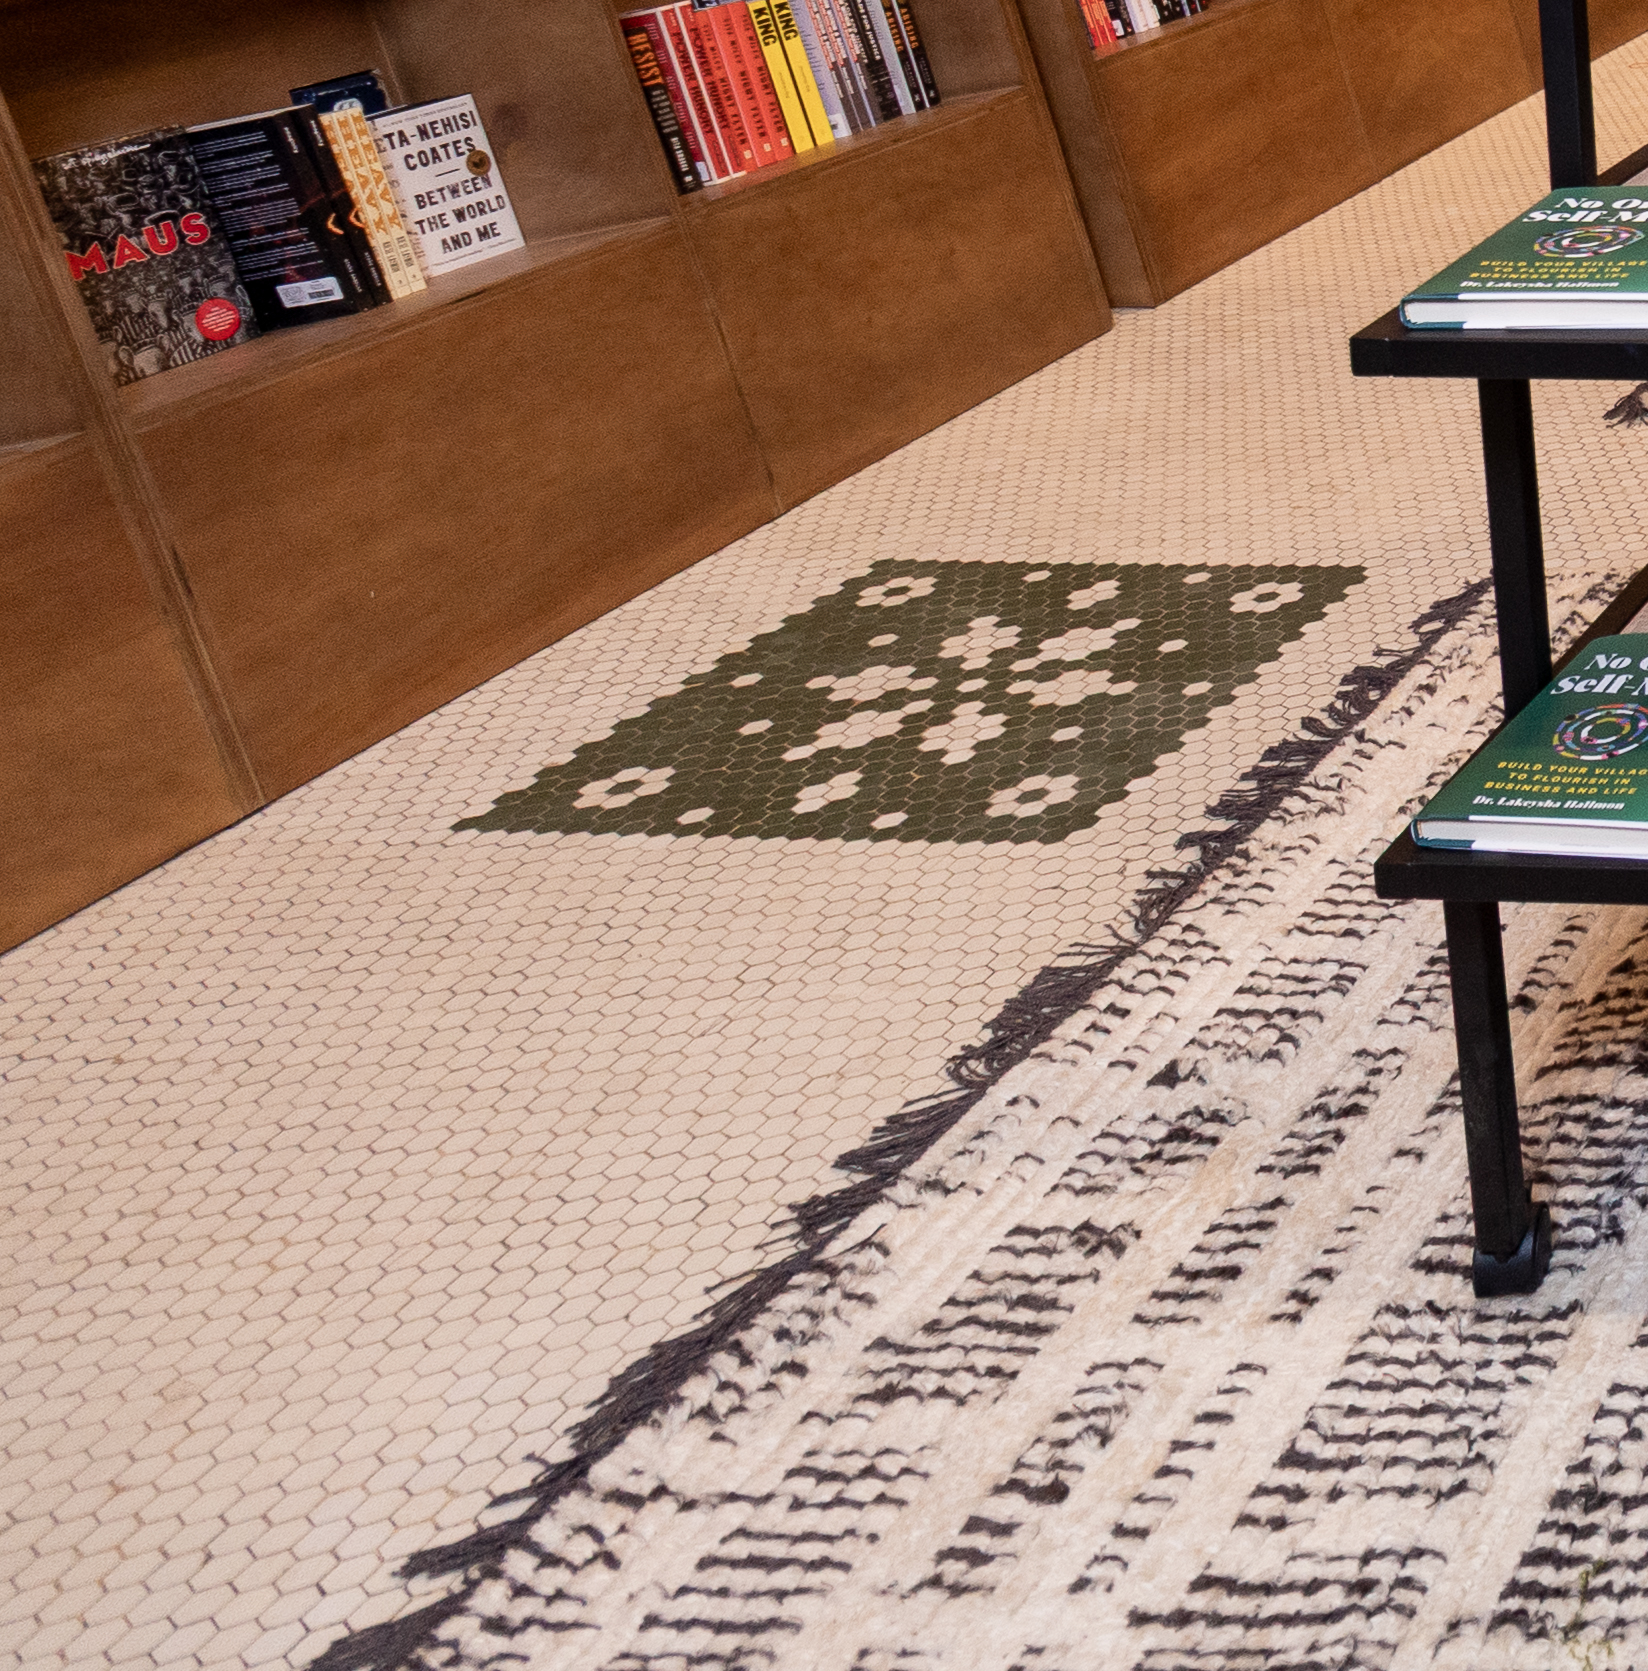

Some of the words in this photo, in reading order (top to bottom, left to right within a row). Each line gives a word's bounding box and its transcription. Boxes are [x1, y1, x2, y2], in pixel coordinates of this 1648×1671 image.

[773, 1, 799, 41] KING
[403, 136, 477, 171] COATES
[414, 176, 492, 210] BETWEEN
[415, 215, 452, 235] THE
[454, 194, 506, 226] WORLD
[65, 213, 211, 281] MAUS
[441, 233, 474, 255] AND
[477, 223, 502, 243] ME
